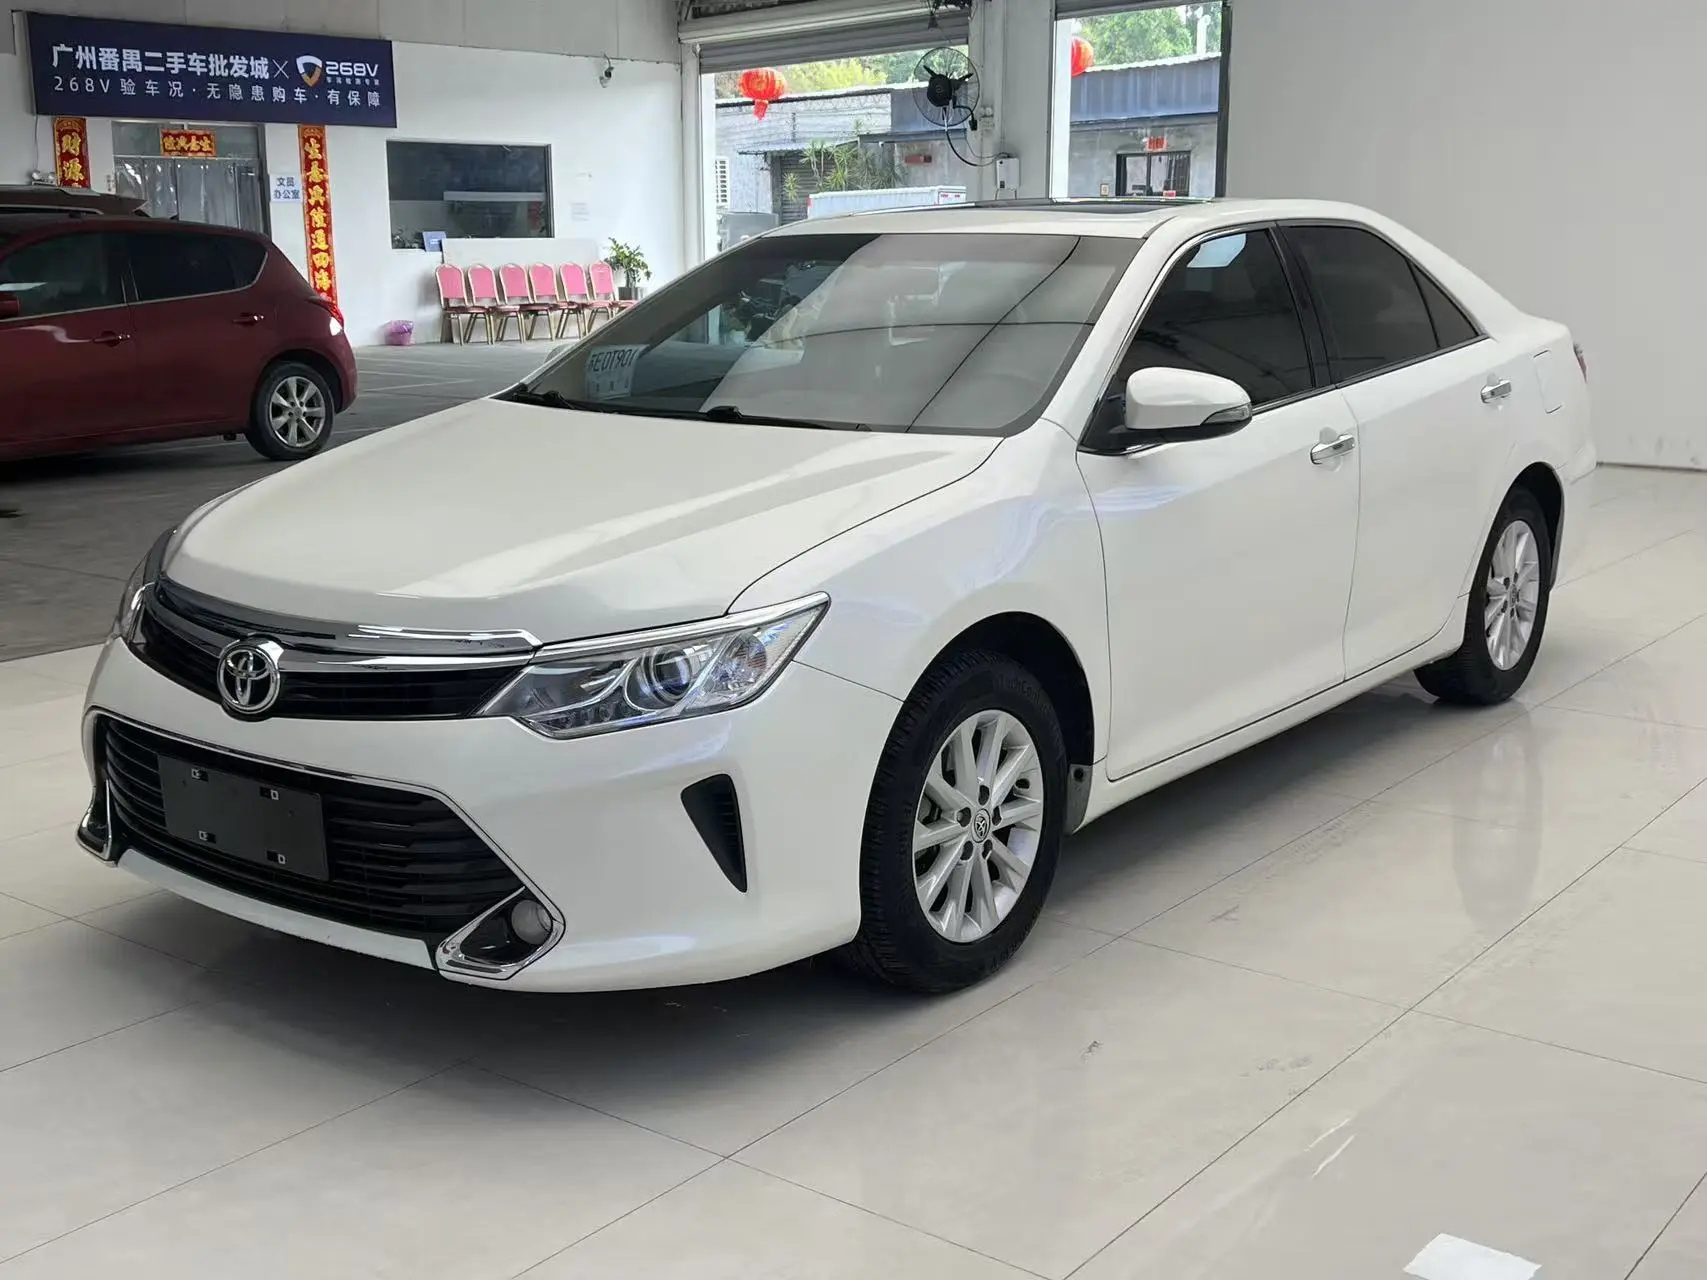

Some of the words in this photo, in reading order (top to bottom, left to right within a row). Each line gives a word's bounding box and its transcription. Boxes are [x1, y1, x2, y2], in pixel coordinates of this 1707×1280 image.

[51, 44, 270, 80] 广州番禺二手车批发城
[325, 60, 379, 78] 268V
